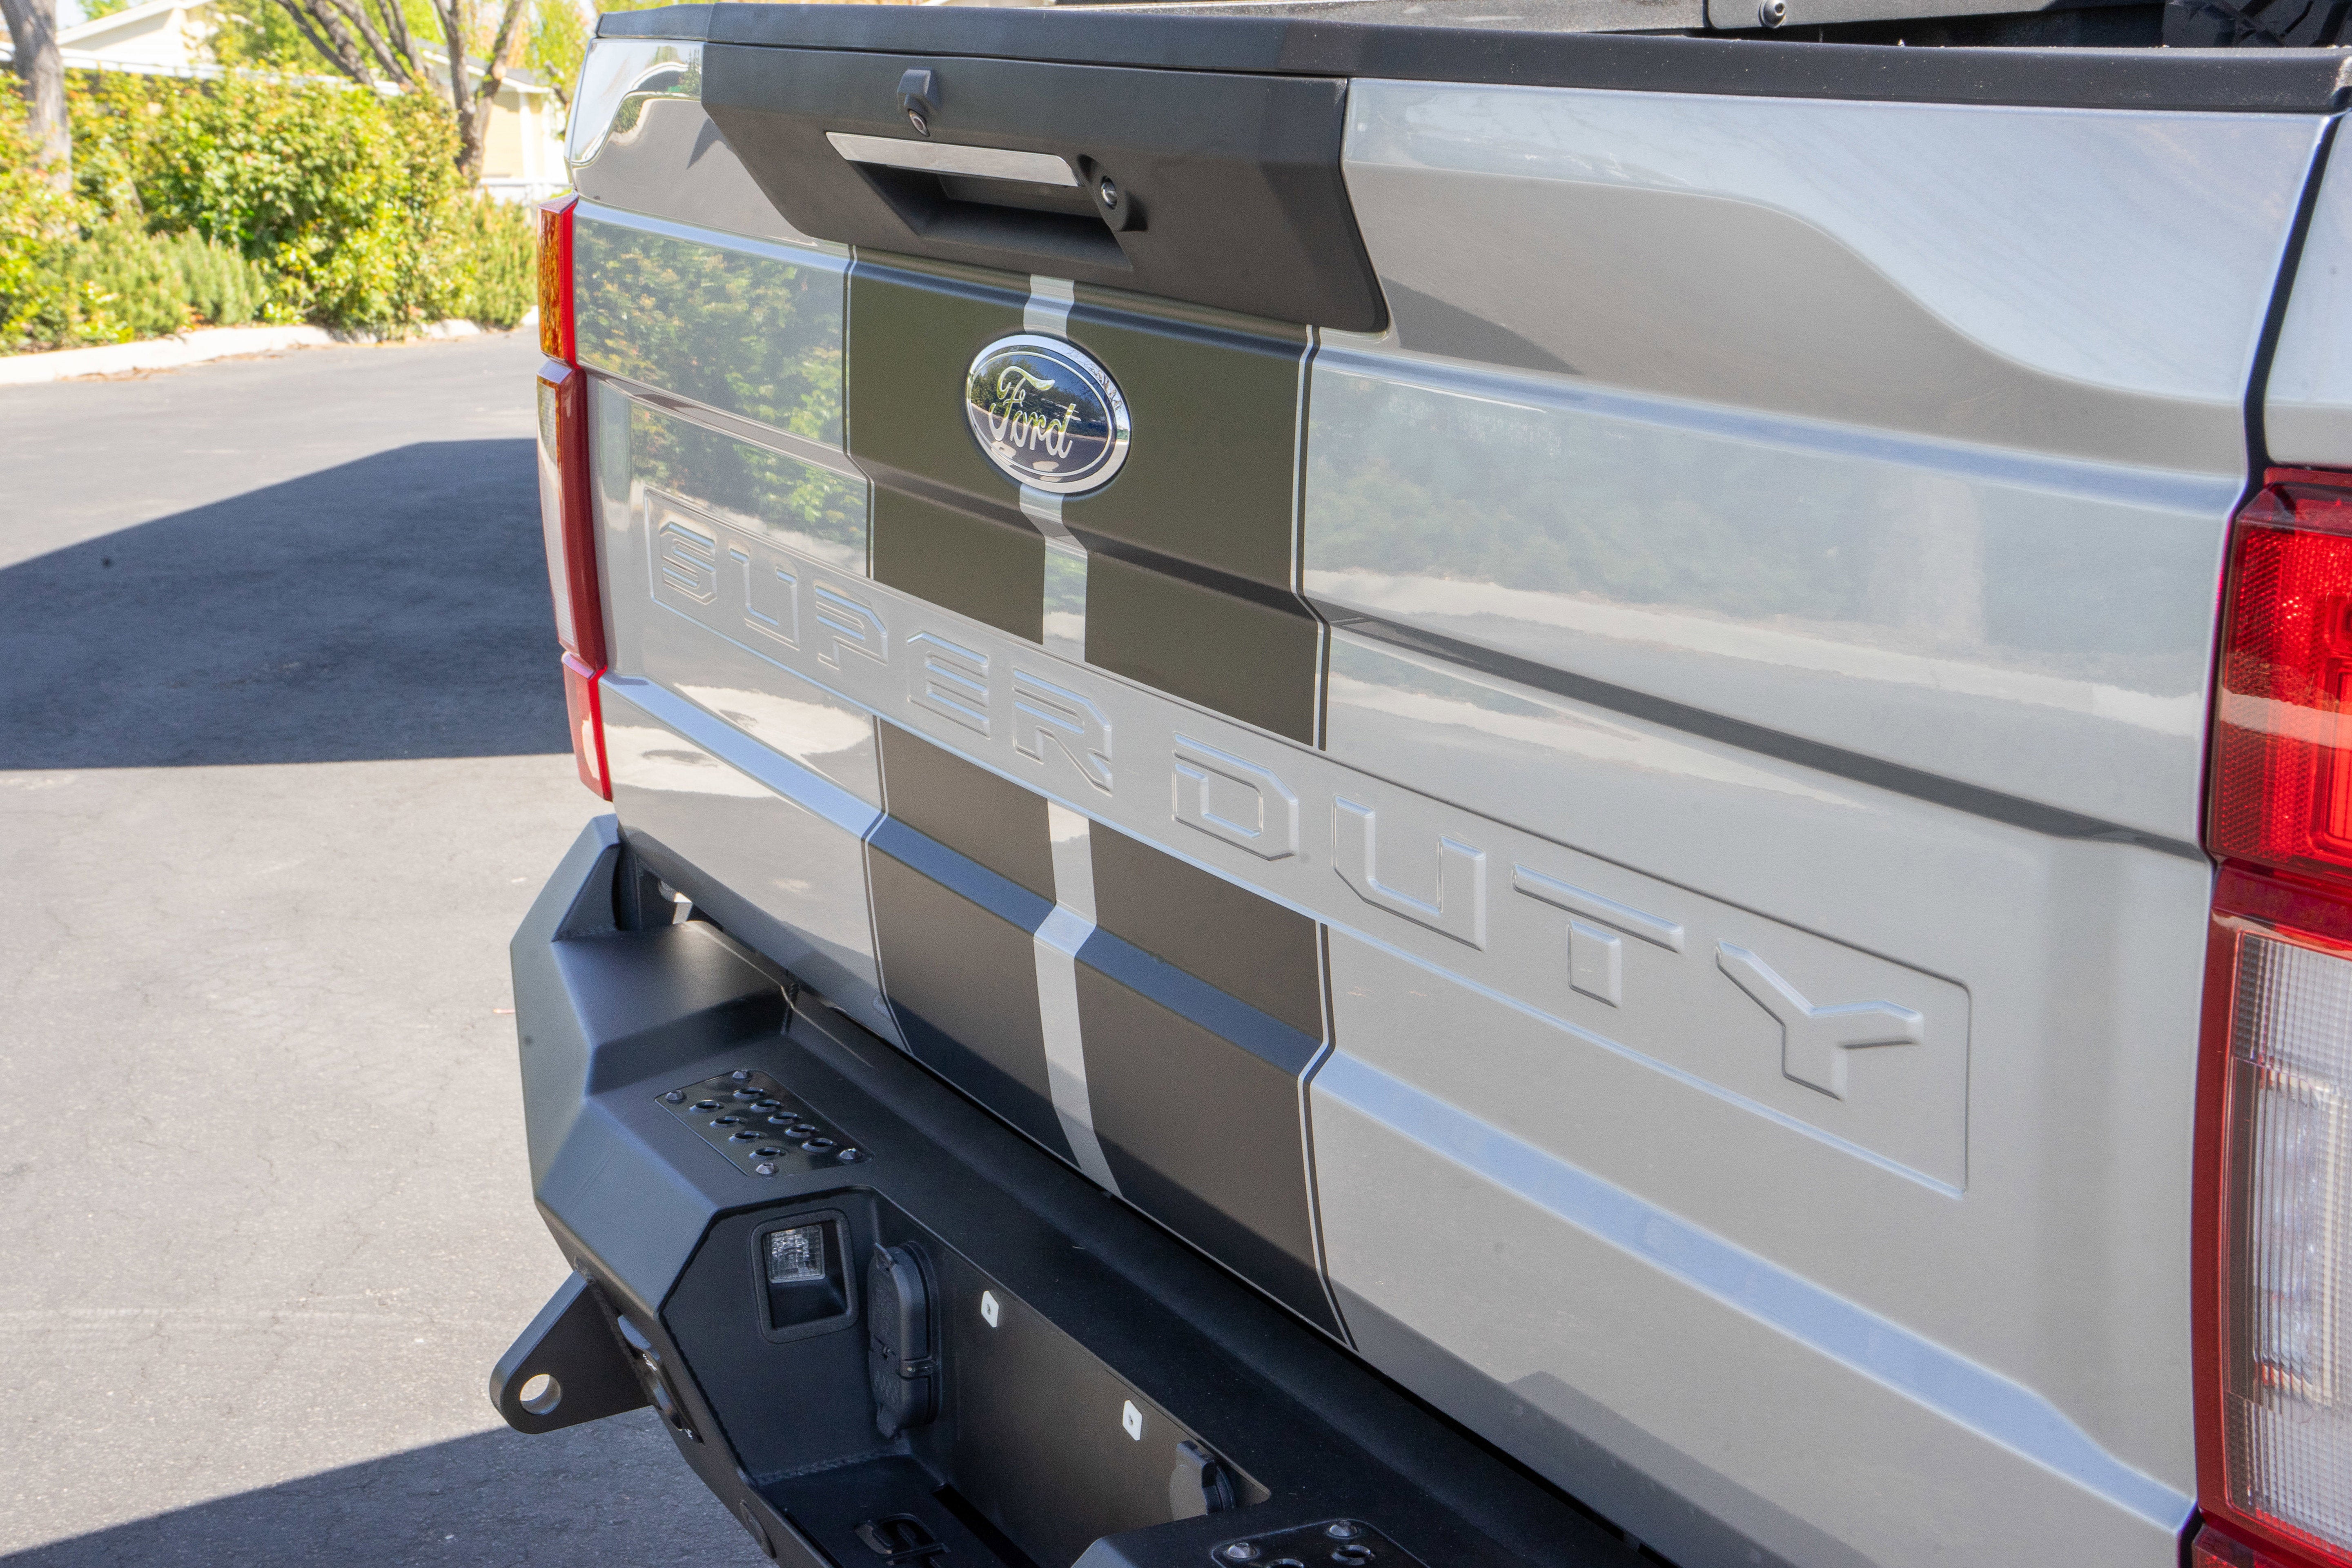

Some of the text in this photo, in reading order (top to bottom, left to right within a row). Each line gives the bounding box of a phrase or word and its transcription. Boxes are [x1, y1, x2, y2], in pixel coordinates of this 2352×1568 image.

[988, 365, 1073, 459] Ford
[659, 521, 1923, 1100] SUPER DUTY
